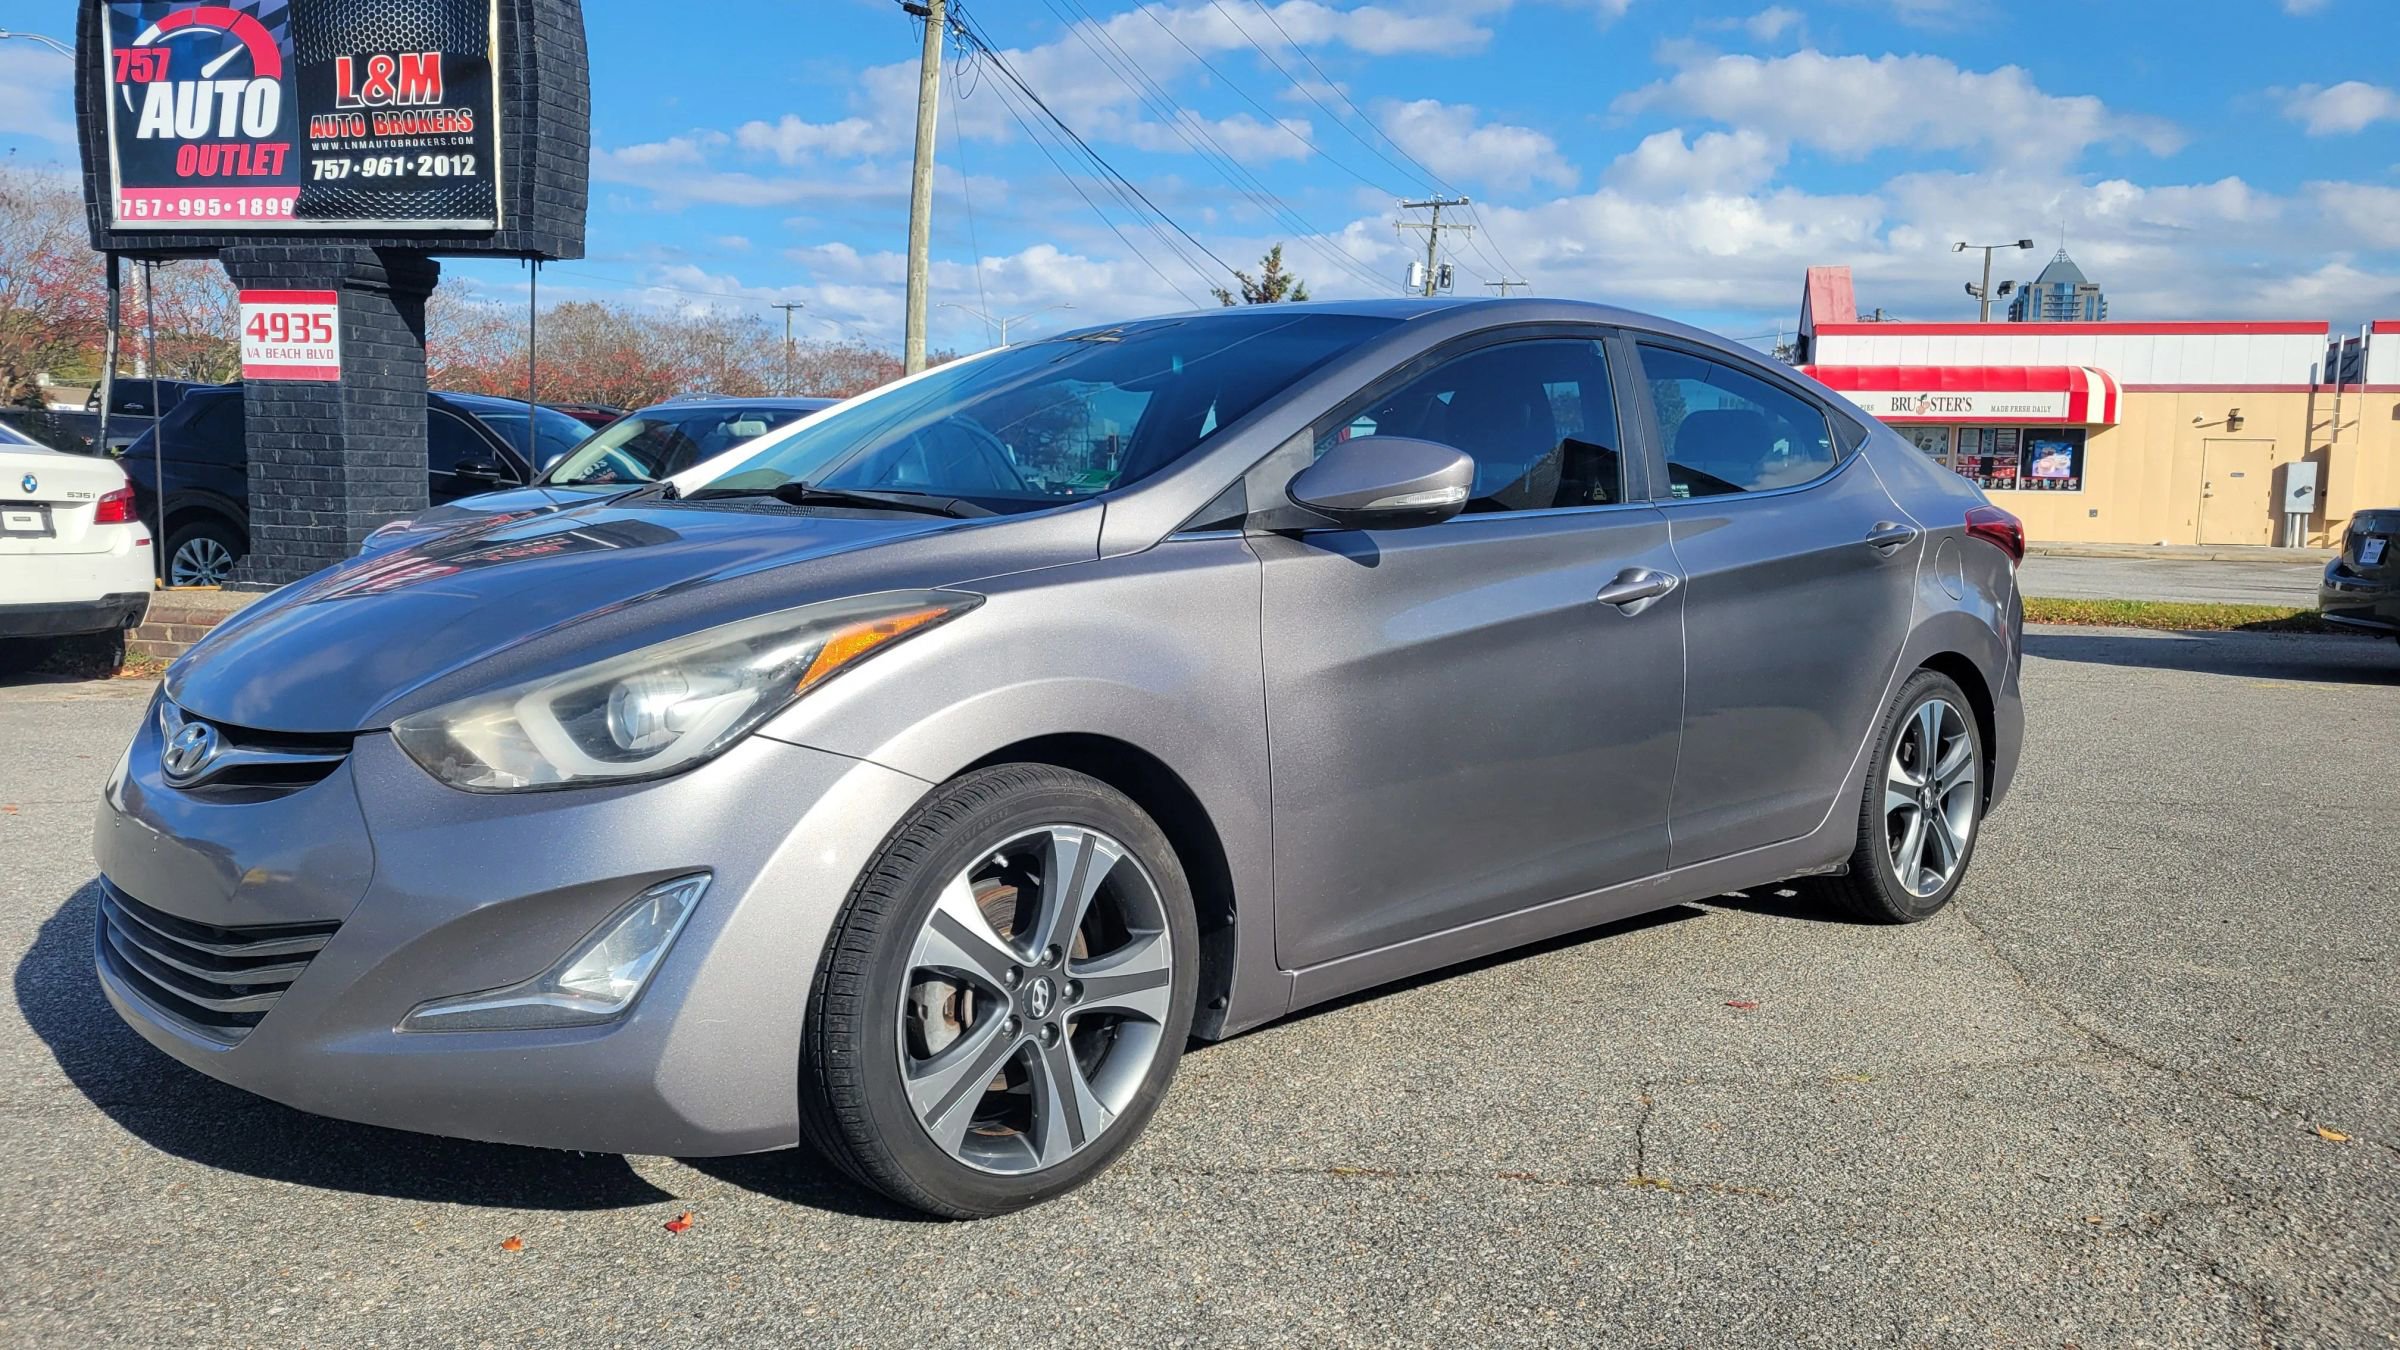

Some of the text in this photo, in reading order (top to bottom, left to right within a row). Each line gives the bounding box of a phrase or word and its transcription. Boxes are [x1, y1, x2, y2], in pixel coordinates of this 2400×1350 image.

[112, 48, 171, 82] 757
[336, 52, 442, 108] L&M
[136, 78, 281, 139] AUTO
[310, 108, 474, 138] AUTO BROKERS
[312, 137, 474, 150] WWW.LNMAUTOBROKERS.COM
[175, 143, 290, 177] OUTLET
[246, 312, 332, 343] 4935
[247, 347, 334, 359] VA BEACH BLVD
